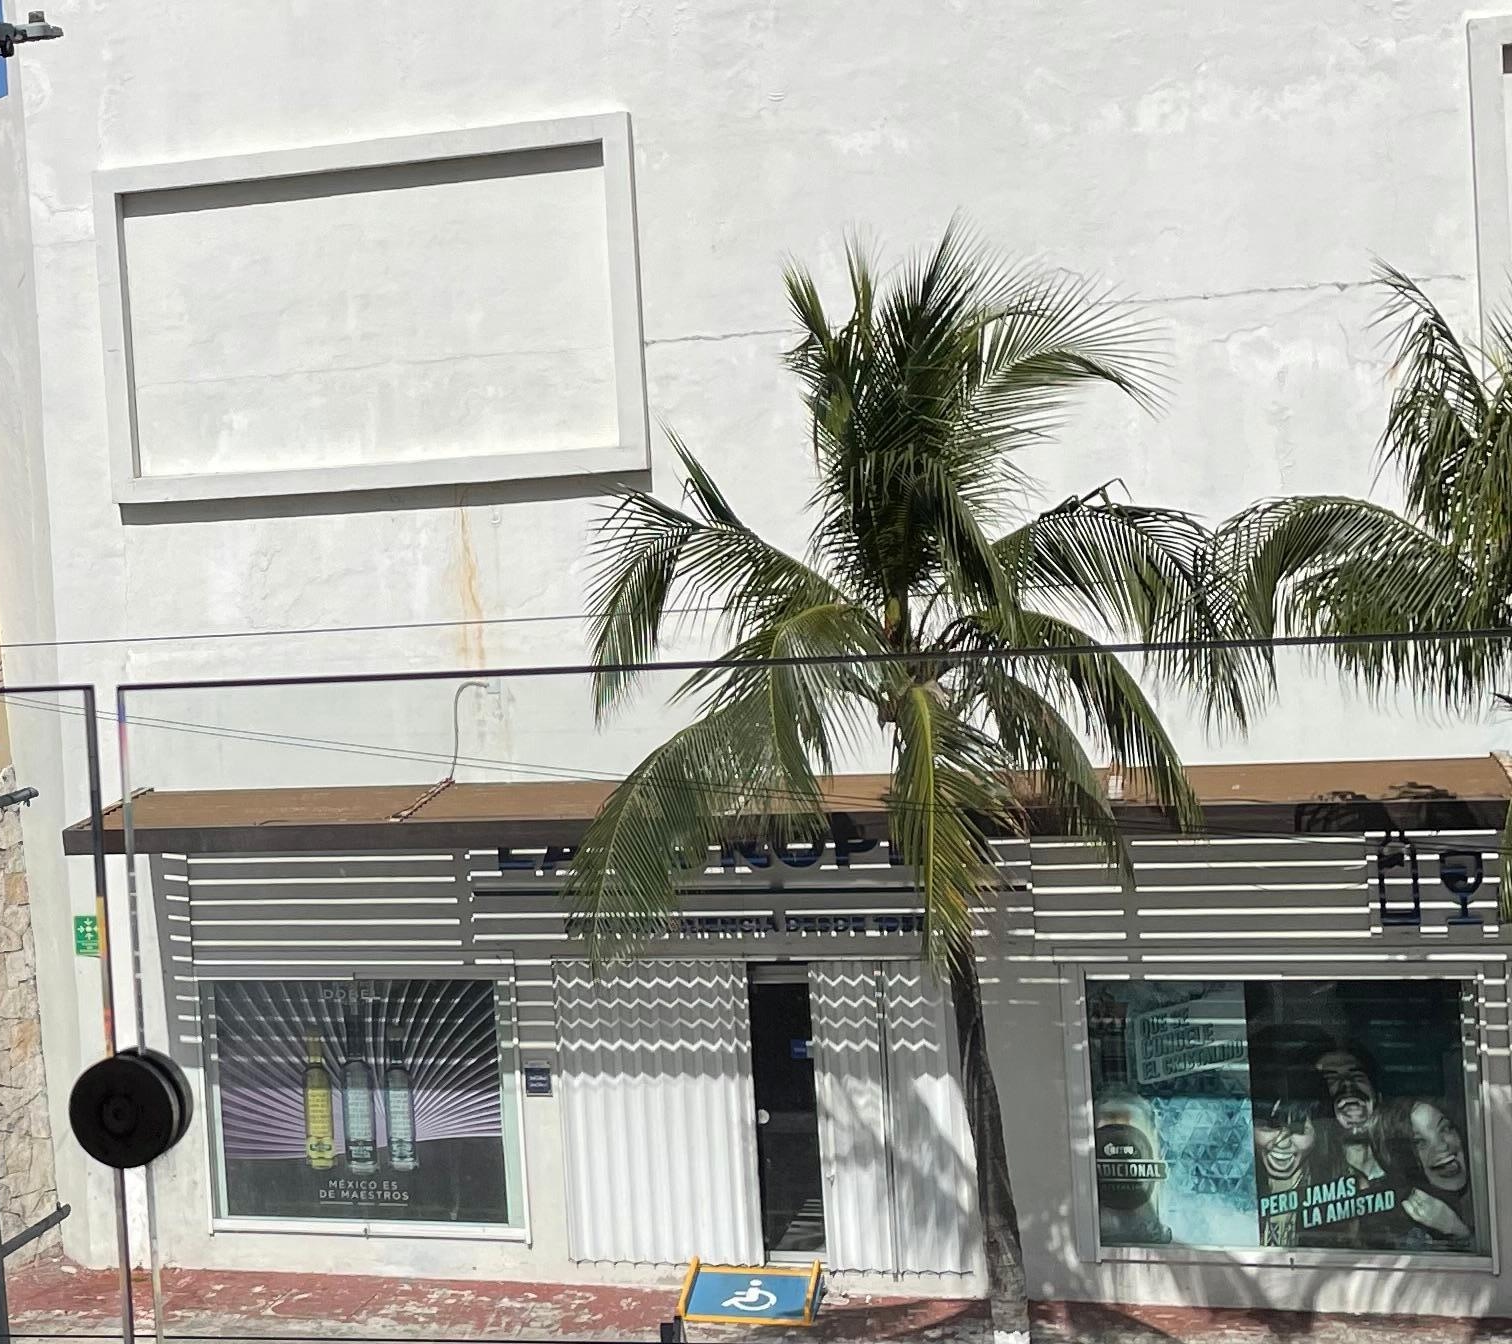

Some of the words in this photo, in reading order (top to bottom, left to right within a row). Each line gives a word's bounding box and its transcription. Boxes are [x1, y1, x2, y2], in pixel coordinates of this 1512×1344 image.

[319, 1189, 336, 1199] DE
[341, 1190, 409, 1201] MAESTROS
[328, 1179, 377, 1190] MÉXICO
[383, 1181, 398, 1190] ES
[1260, 1191, 1298, 1216] PERO
[1302, 1176, 1356, 1207] JAMÁS
[1302, 1206, 1322, 1229] LA
[1326, 1190, 1395, 1223] AMISTAD
